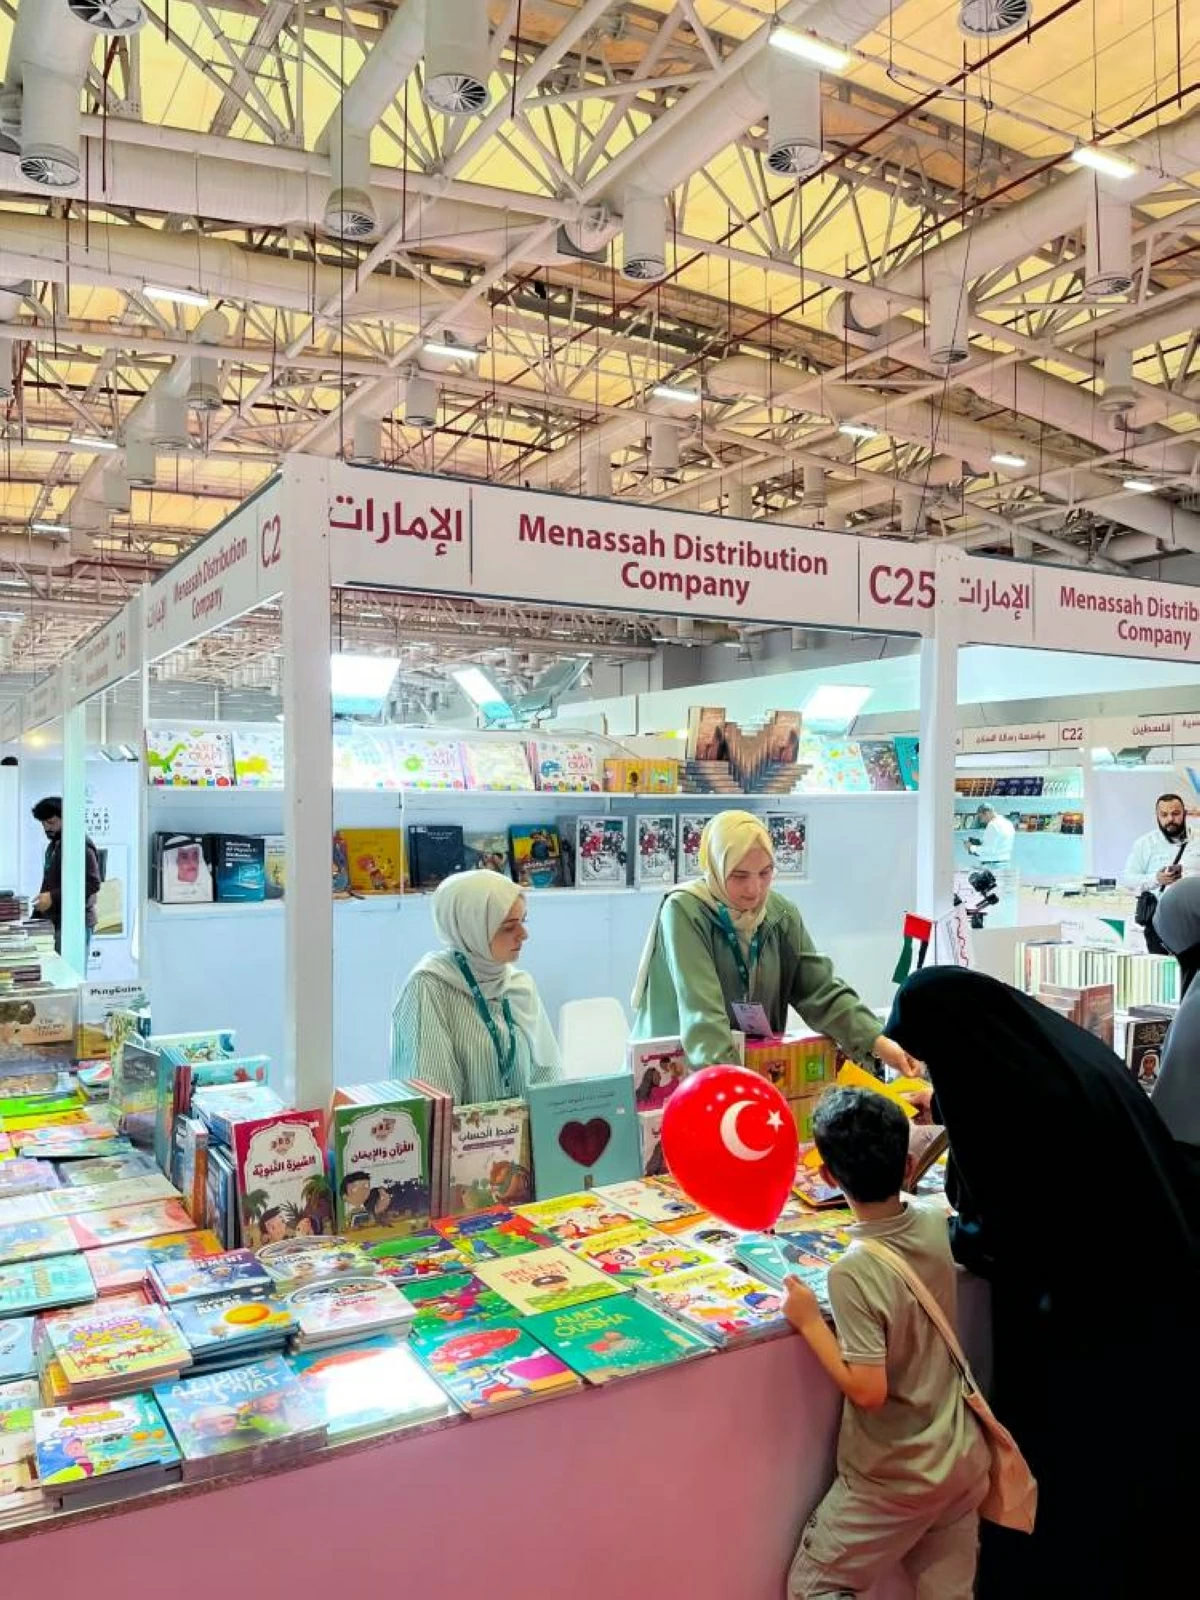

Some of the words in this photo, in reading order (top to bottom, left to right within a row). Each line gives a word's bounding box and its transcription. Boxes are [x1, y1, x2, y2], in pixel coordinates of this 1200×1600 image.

[330, 495, 462, 556] الإمارات
[518, 513, 665, 560] Menassah
[673, 533, 829, 575] Distribution
[203, 536, 248, 584] Distribution
[191, 587, 223, 620] Company
[621, 562, 750, 605] Company
[869, 565, 936, 609] C25
[959, 577, 1030, 620] الإمارات
[1060, 586, 1143, 616] Menassah
[1147, 597, 1200, 622] Distrib
[1118, 619, 1192, 650] Company
[1062, 728, 1083, 742] C22
